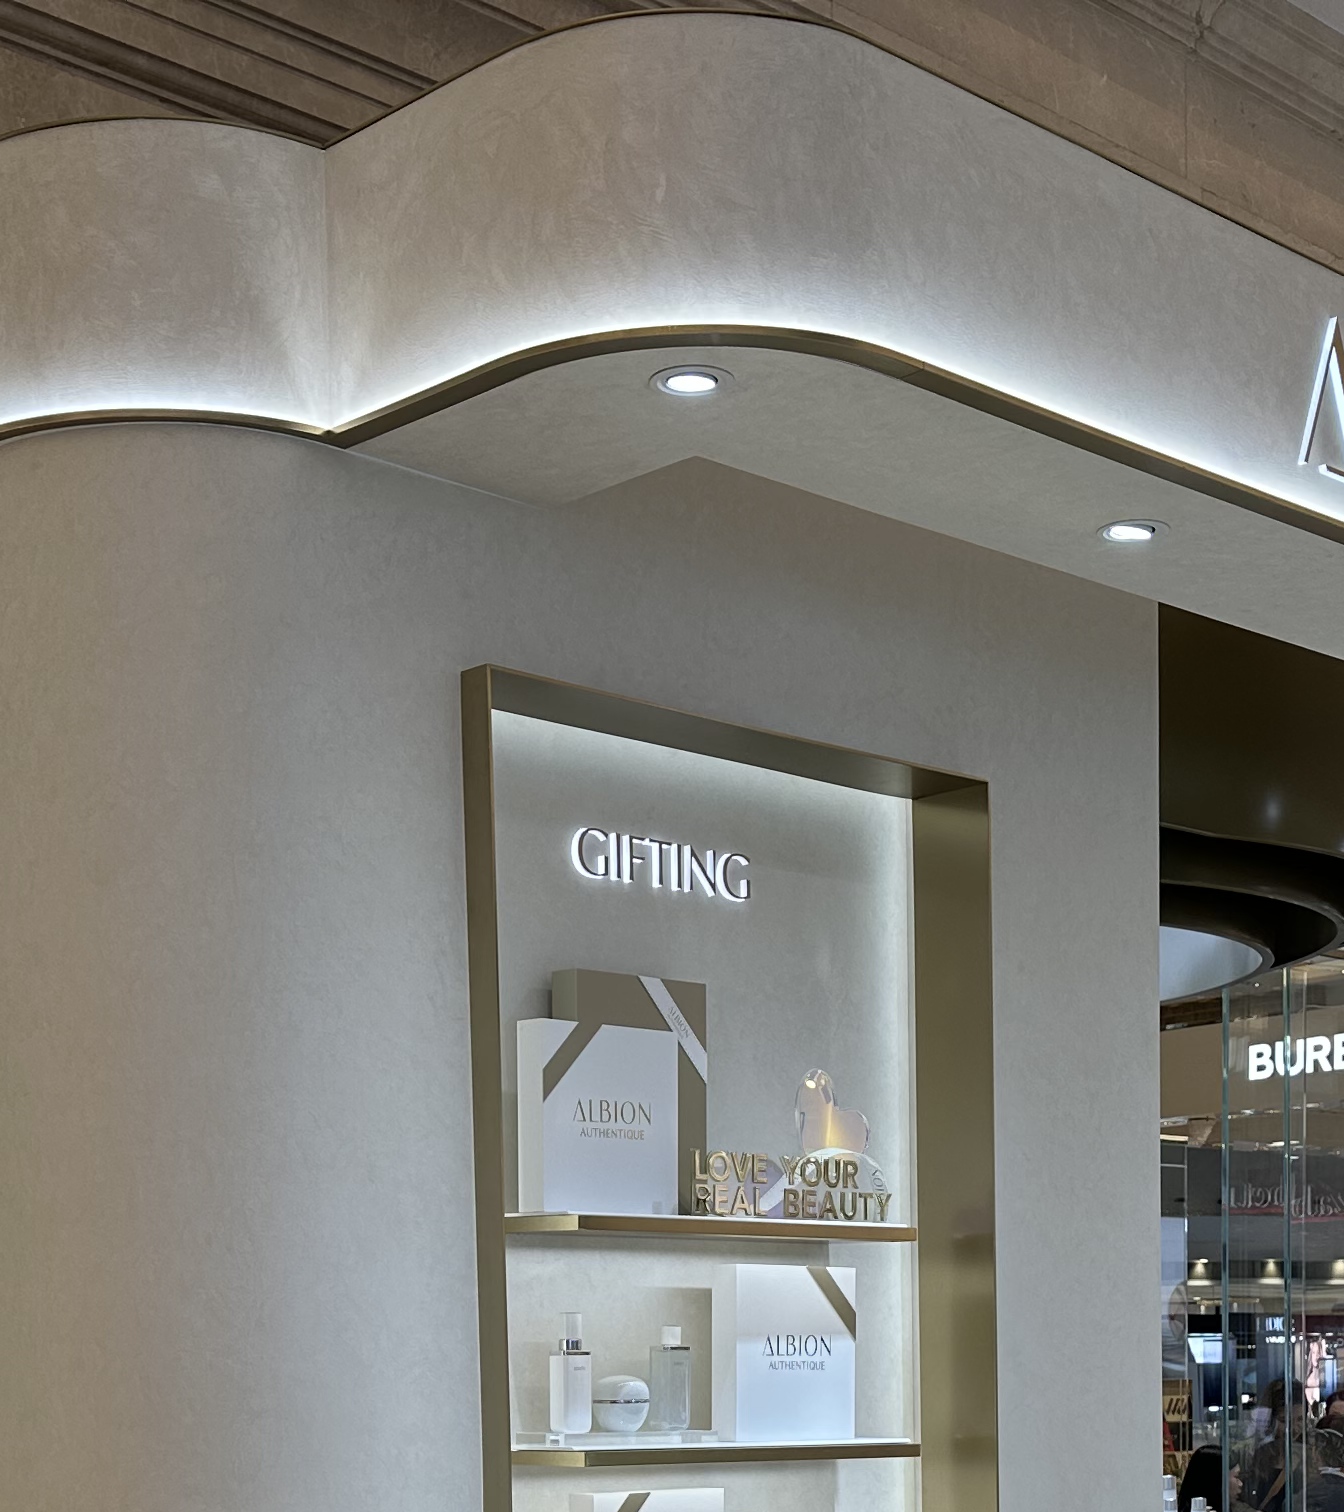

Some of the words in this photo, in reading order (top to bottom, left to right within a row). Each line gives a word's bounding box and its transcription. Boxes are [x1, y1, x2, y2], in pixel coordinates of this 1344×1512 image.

[571, 827, 751, 902] GIFTING
[572, 1098, 652, 1126] ALBION
[579, 1127, 645, 1141] AUTHENTIQUE
[692, 1148, 768, 1185] LOVE
[780, 1155, 859, 1190] YOUR
[692, 1184, 768, 1217] REAL
[783, 1188, 893, 1222] BEAUTY
[762, 1334, 832, 1356] ALBION
[768, 1361, 825, 1371] AUTHENTIQUE
